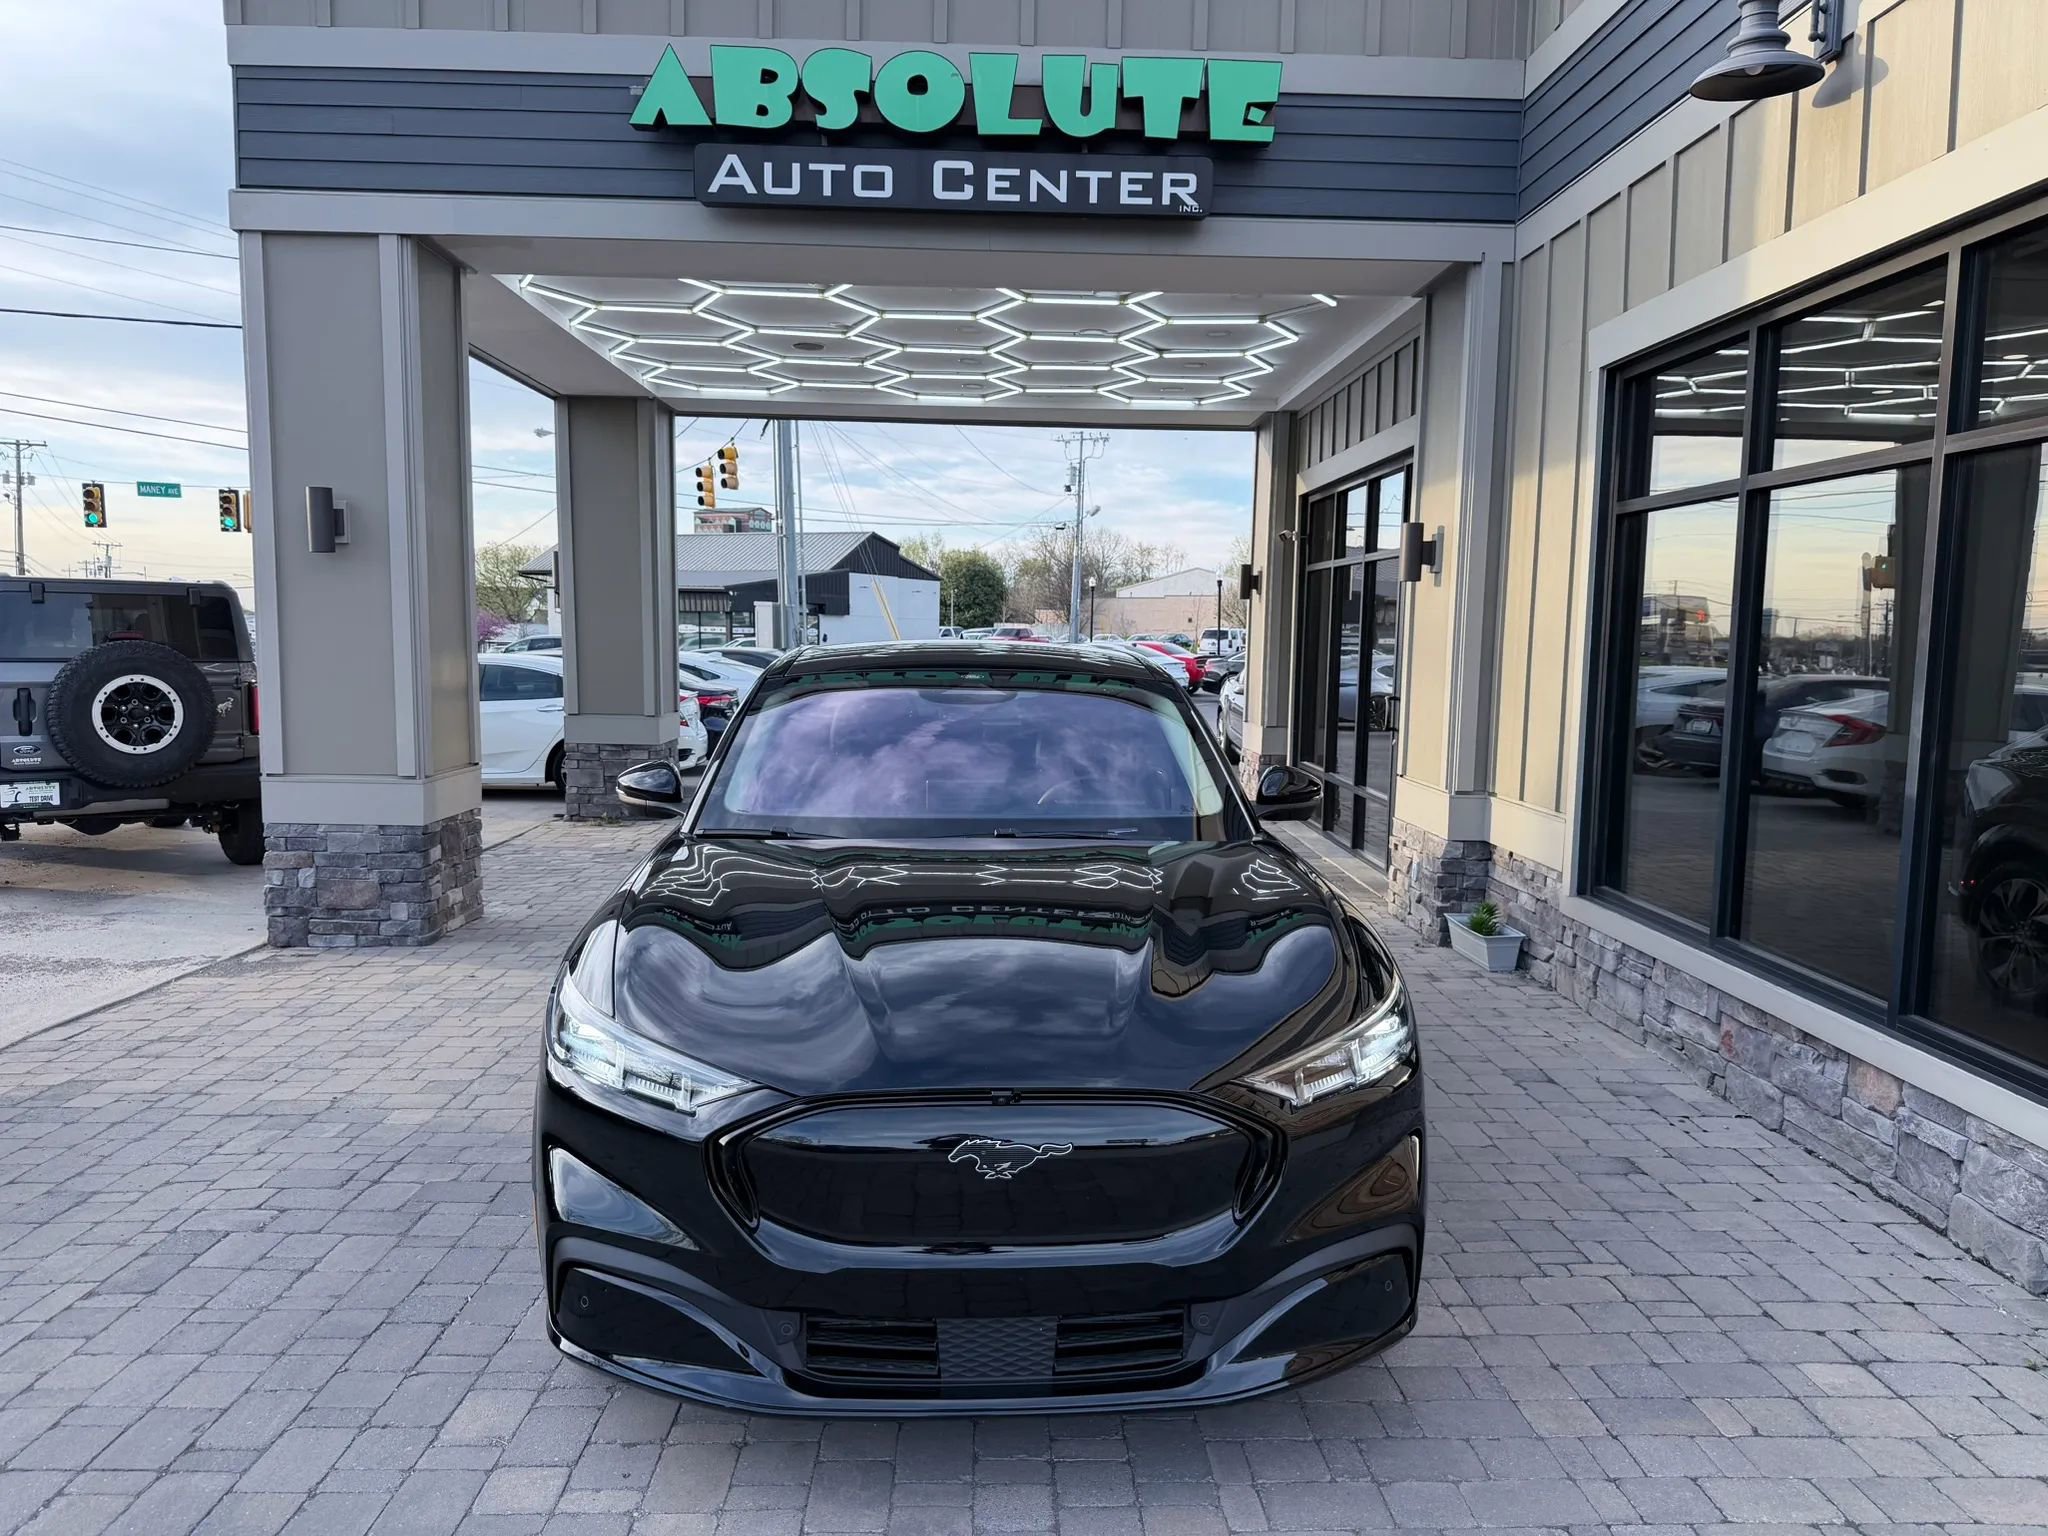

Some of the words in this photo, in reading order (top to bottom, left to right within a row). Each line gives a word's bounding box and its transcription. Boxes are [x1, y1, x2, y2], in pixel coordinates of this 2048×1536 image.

[628, 43, 1284, 143] ABSOLUTE
[706, 153, 894, 198] AUTO
[932, 159, 1200, 206] CENTER
[1178, 204, 1204, 213] INC.
[139, 484, 166, 495] MANEY
